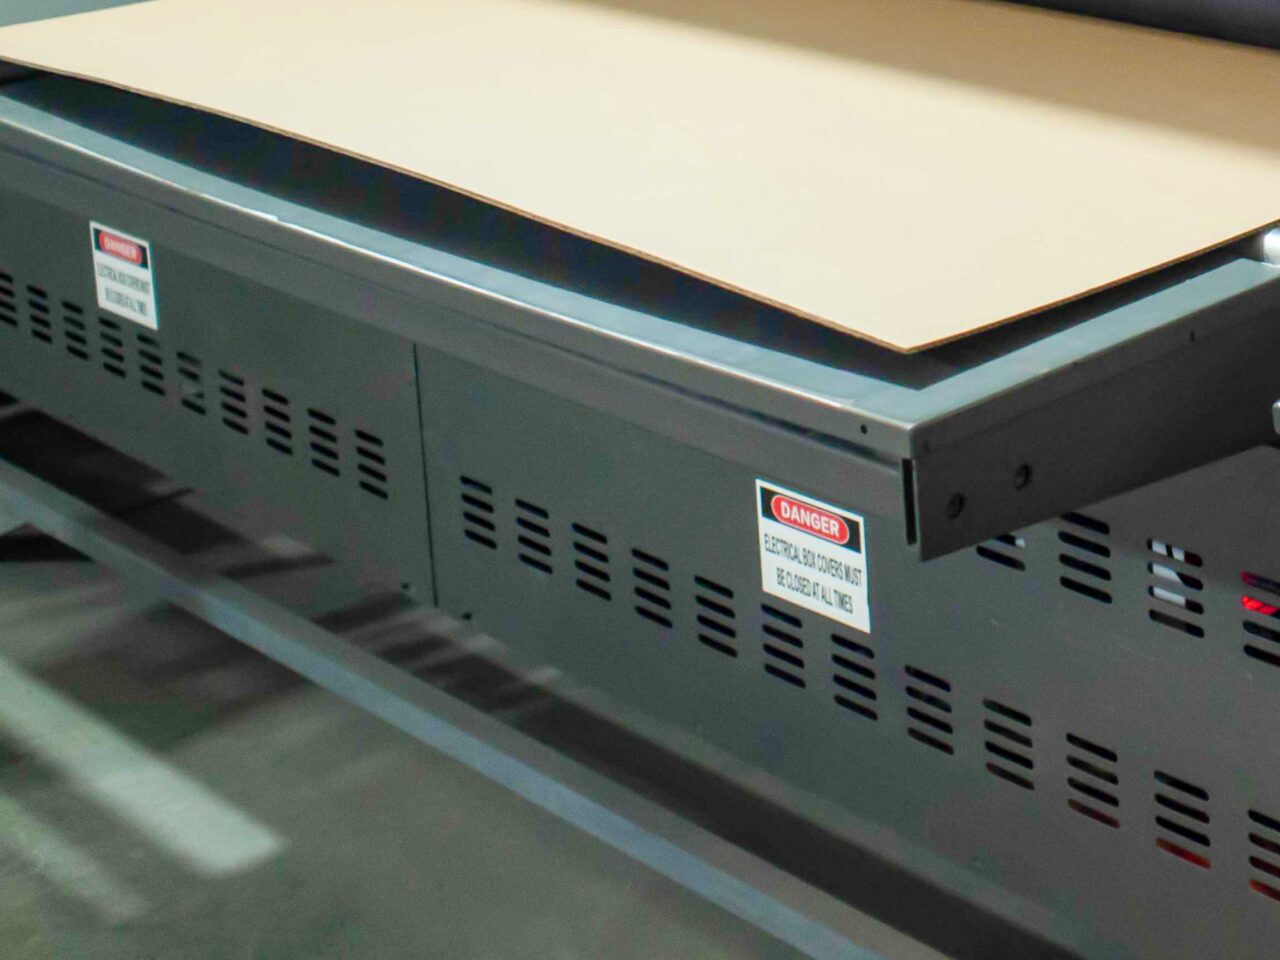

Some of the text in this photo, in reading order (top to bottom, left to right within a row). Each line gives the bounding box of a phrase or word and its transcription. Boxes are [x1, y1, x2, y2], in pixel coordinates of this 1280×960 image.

[780, 501, 840, 538] DANGER
[764, 533, 862, 587] ELECTRICAL BOX COVERS MUST
[776, 567, 854, 614] BE CLOSED AT ALL TIMES
